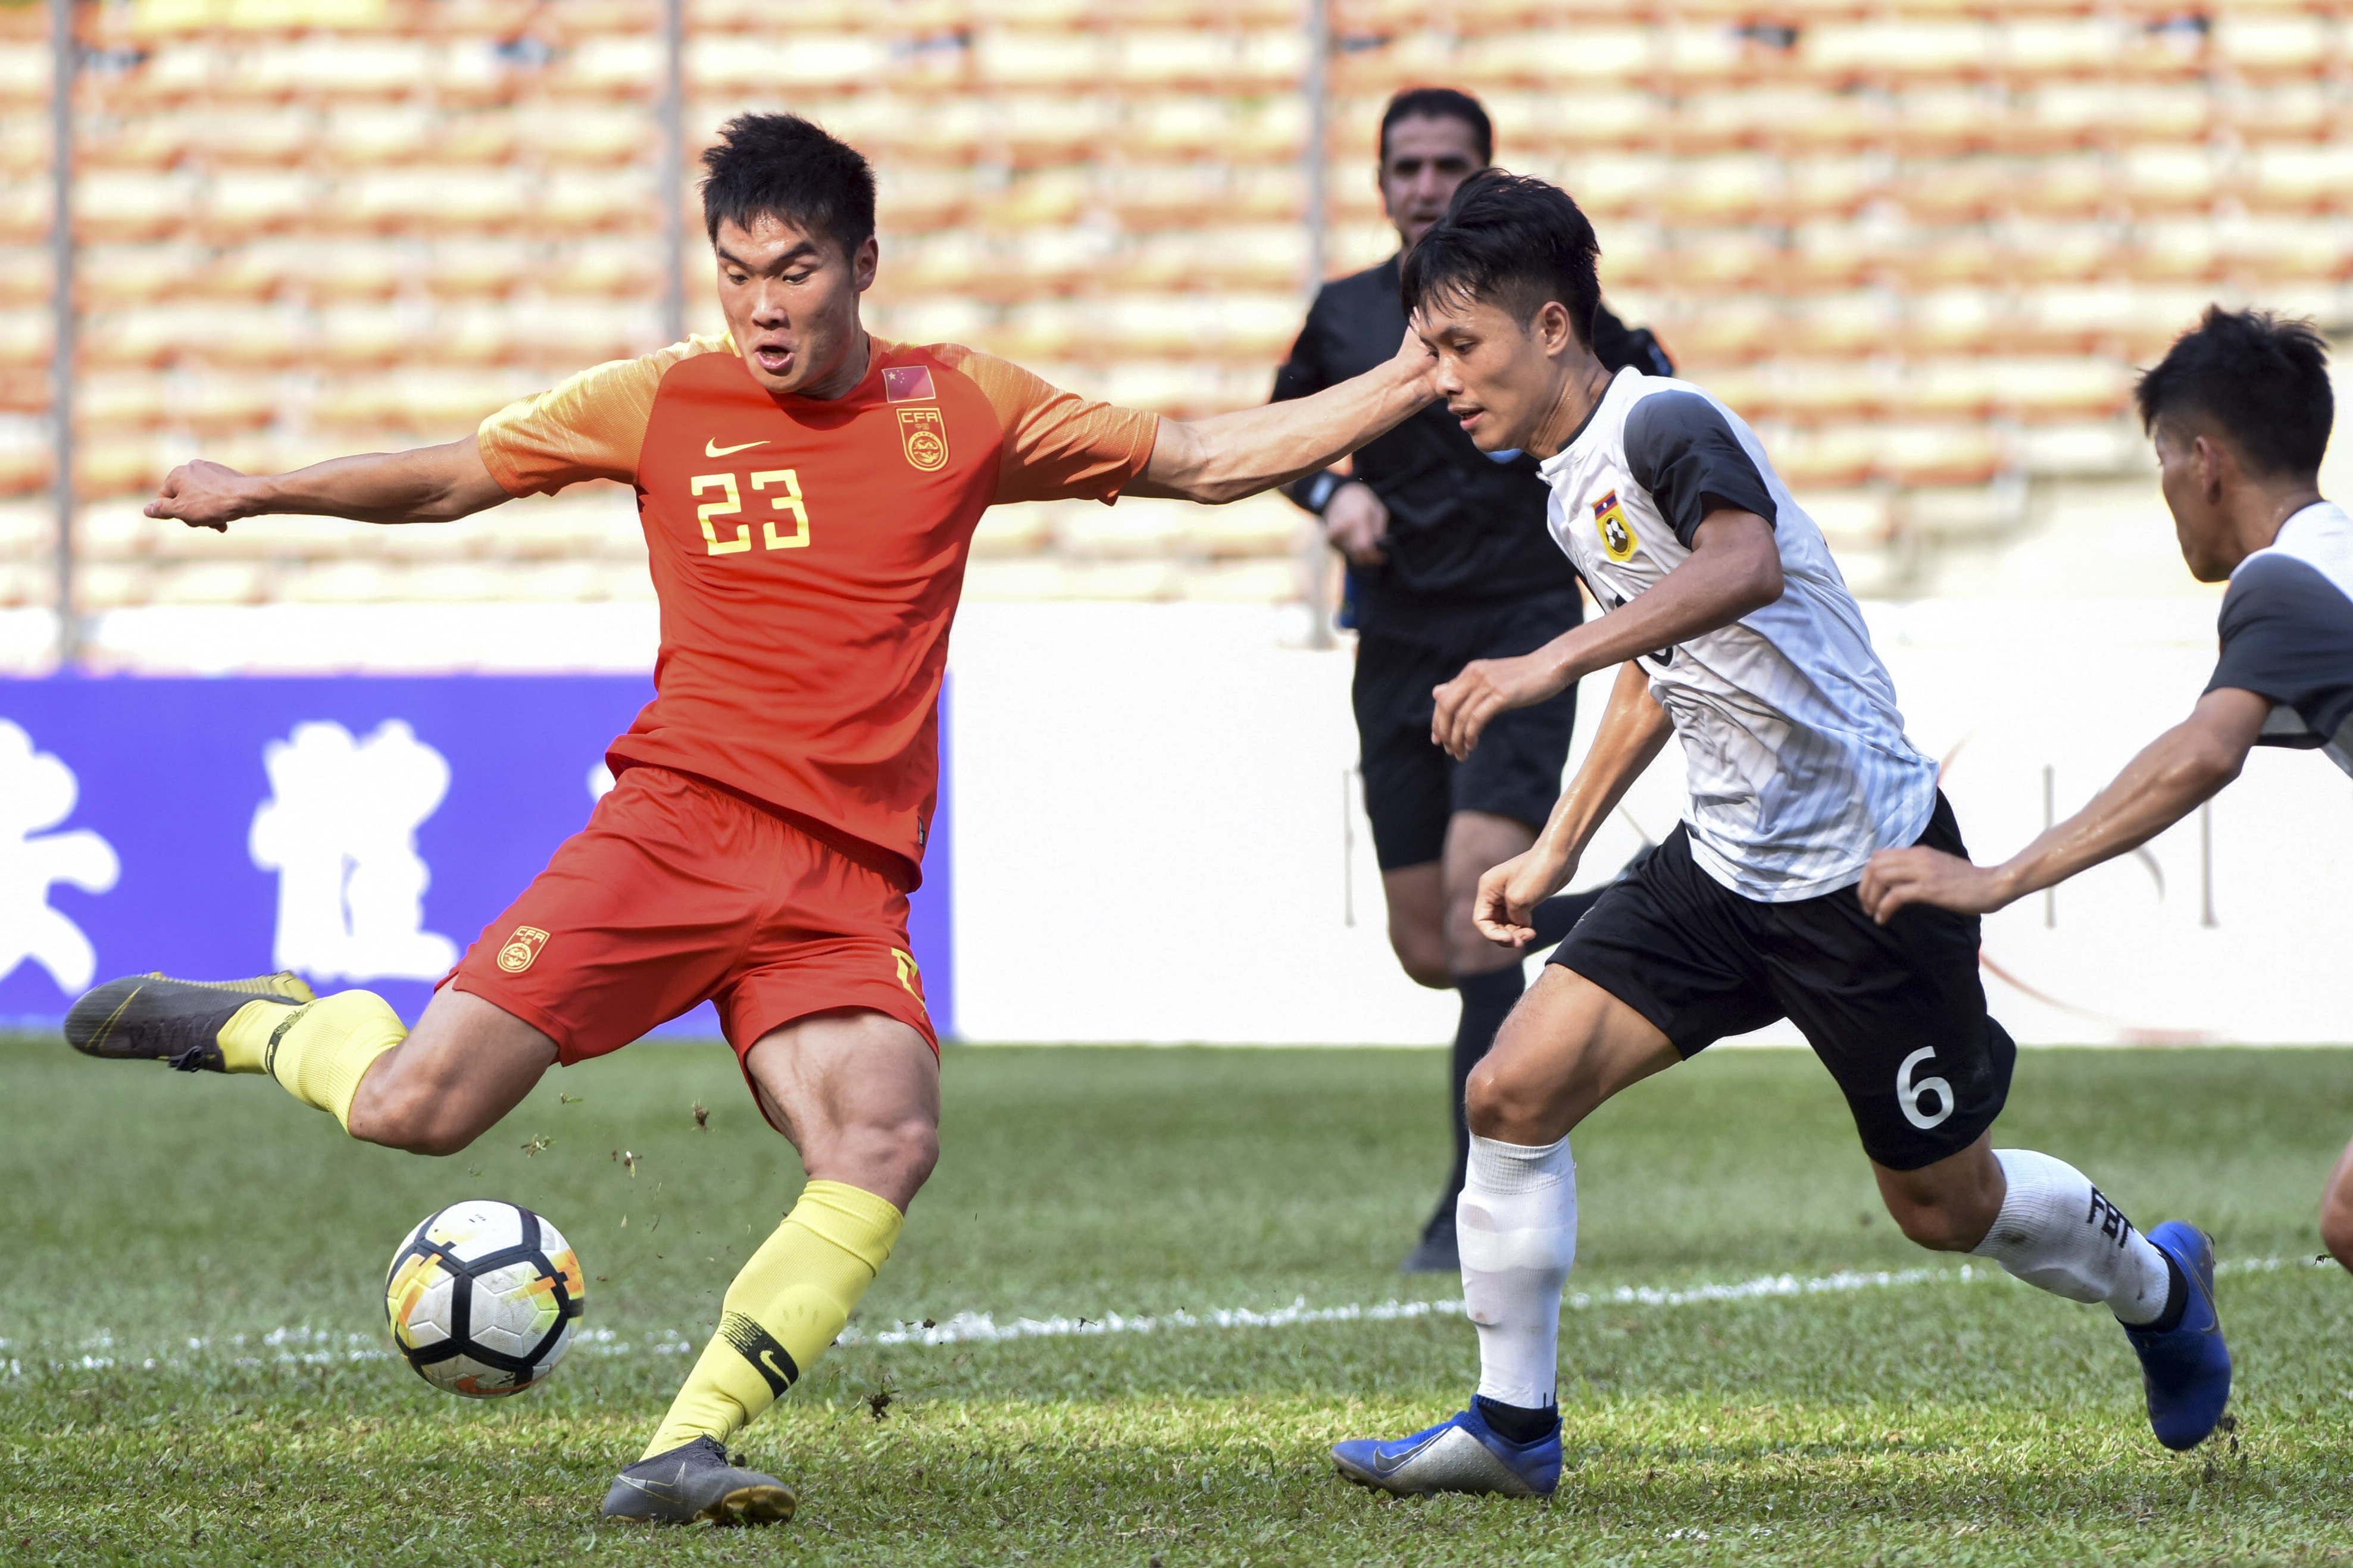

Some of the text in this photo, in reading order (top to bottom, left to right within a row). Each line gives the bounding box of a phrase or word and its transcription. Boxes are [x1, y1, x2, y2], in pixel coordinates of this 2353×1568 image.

[901, 412, 938, 422] CFA
[690, 469, 810, 556] 23
[517, 929, 545, 942] CFA
[1896, 1046, 1954, 1129] 6
